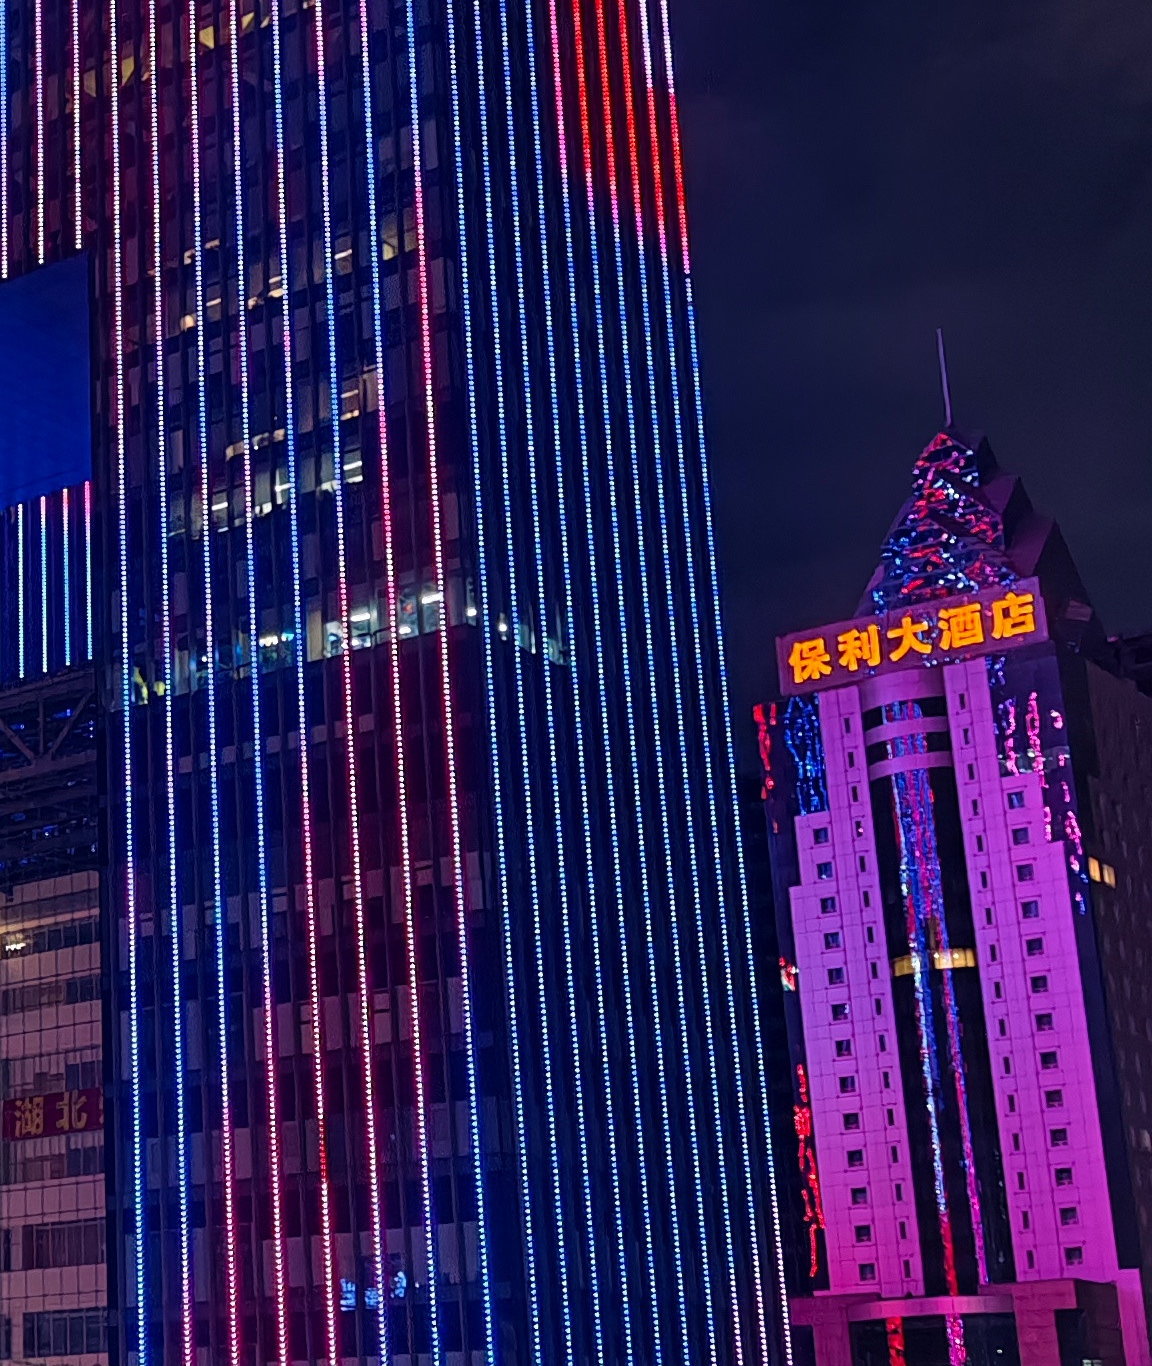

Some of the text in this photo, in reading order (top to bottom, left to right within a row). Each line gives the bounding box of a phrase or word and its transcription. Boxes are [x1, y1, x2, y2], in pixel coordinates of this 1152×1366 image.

[788, 591, 1037, 684] 保利大酒店
[14, 1088, 105, 1139] 湖北
